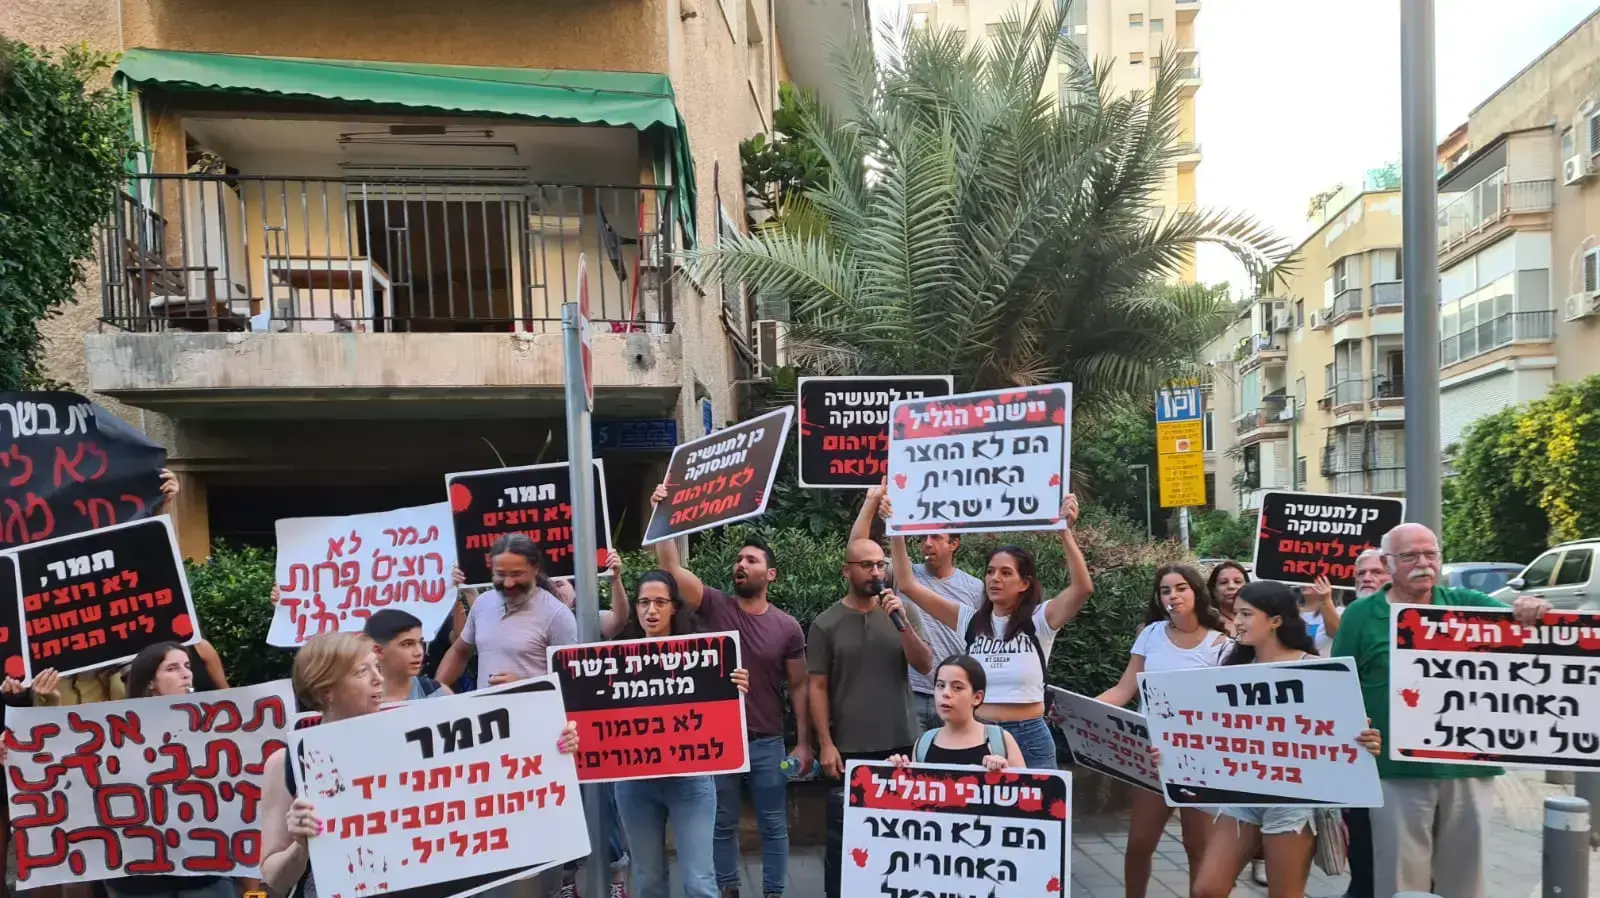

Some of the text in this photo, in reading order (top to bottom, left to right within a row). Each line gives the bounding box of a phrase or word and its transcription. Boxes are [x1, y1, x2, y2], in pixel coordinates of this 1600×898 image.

[824, 387, 901, 406] לתעשיה
[0, 401, 61, 439] בשר
[829, 410, 889, 429] עסוקה
[908, 399, 1047, 431] יישובי הגליל
[685, 432, 748, 465] לתעשיה
[746, 427, 766, 449] כן
[903, 430, 1049, 464] הם לא החצר
[53, 440, 110, 488] לא
[684, 449, 749, 482] ותעסוקה
[917, 464, 1025, 494] האחורית
[497, 482, 557, 508] תמר,
[671, 462, 756, 506] לא לזיהום
[482, 502, 573, 527] לא רוצים
[668, 492, 744, 526] ותחלואה
[907, 491, 1039, 522] של ישראל.
[1283, 503, 1380, 524] כן לתעשיה
[327, 525, 440, 561] תמר לא
[1286, 519, 1364, 536] ותעסוקה
[1278, 537, 1345, 558] לזיהום
[39, 549, 116, 588] תמר,
[1282, 555, 1356, 579] תחלואה
[23, 569, 140, 613] לא רוצים
[109, 587, 174, 617] פרות
[337, 577, 447, 611] שחוטות
[25, 604, 102, 637] שחוטו
[111, 614, 156, 640] ליד
[1419, 616, 1600, 647] יישובי הגליל
[30, 627, 107, 660] הבית!
[567, 648, 720, 679] תעשיית בשר
[1412, 657, 1499, 681] החצר
[1508, 653, 1551, 686] לא
[611, 676, 696, 700] מזהמת
[1215, 679, 1305, 707] תמר
[1433, 690, 1580, 720] האחורית
[66, 710, 146, 758] אל
[404, 707, 511, 760] תמר
[591, 708, 704, 742] לא בסמוך
[1106, 714, 1150, 740] מר
[1178, 708, 1336, 737] אל תיתני יד
[1423, 715, 1600, 754] של ישראל.
[576, 737, 725, 769] לבתי מגורים!
[1162, 730, 1358, 765] לזיהום הסביבתי
[351, 753, 543, 800] אל תיתני יד
[1214, 757, 1304, 785] בגליל.
[95, 779, 262, 828] זיהום
[871, 773, 1043, 808] יישובי הגליל
[326, 781, 567, 840] לזיהום הסביבתי
[400, 827, 510, 867] בגליל.
[863, 815, 1047, 851] הם לא החצר
[880, 850, 1019, 885] האחורית
